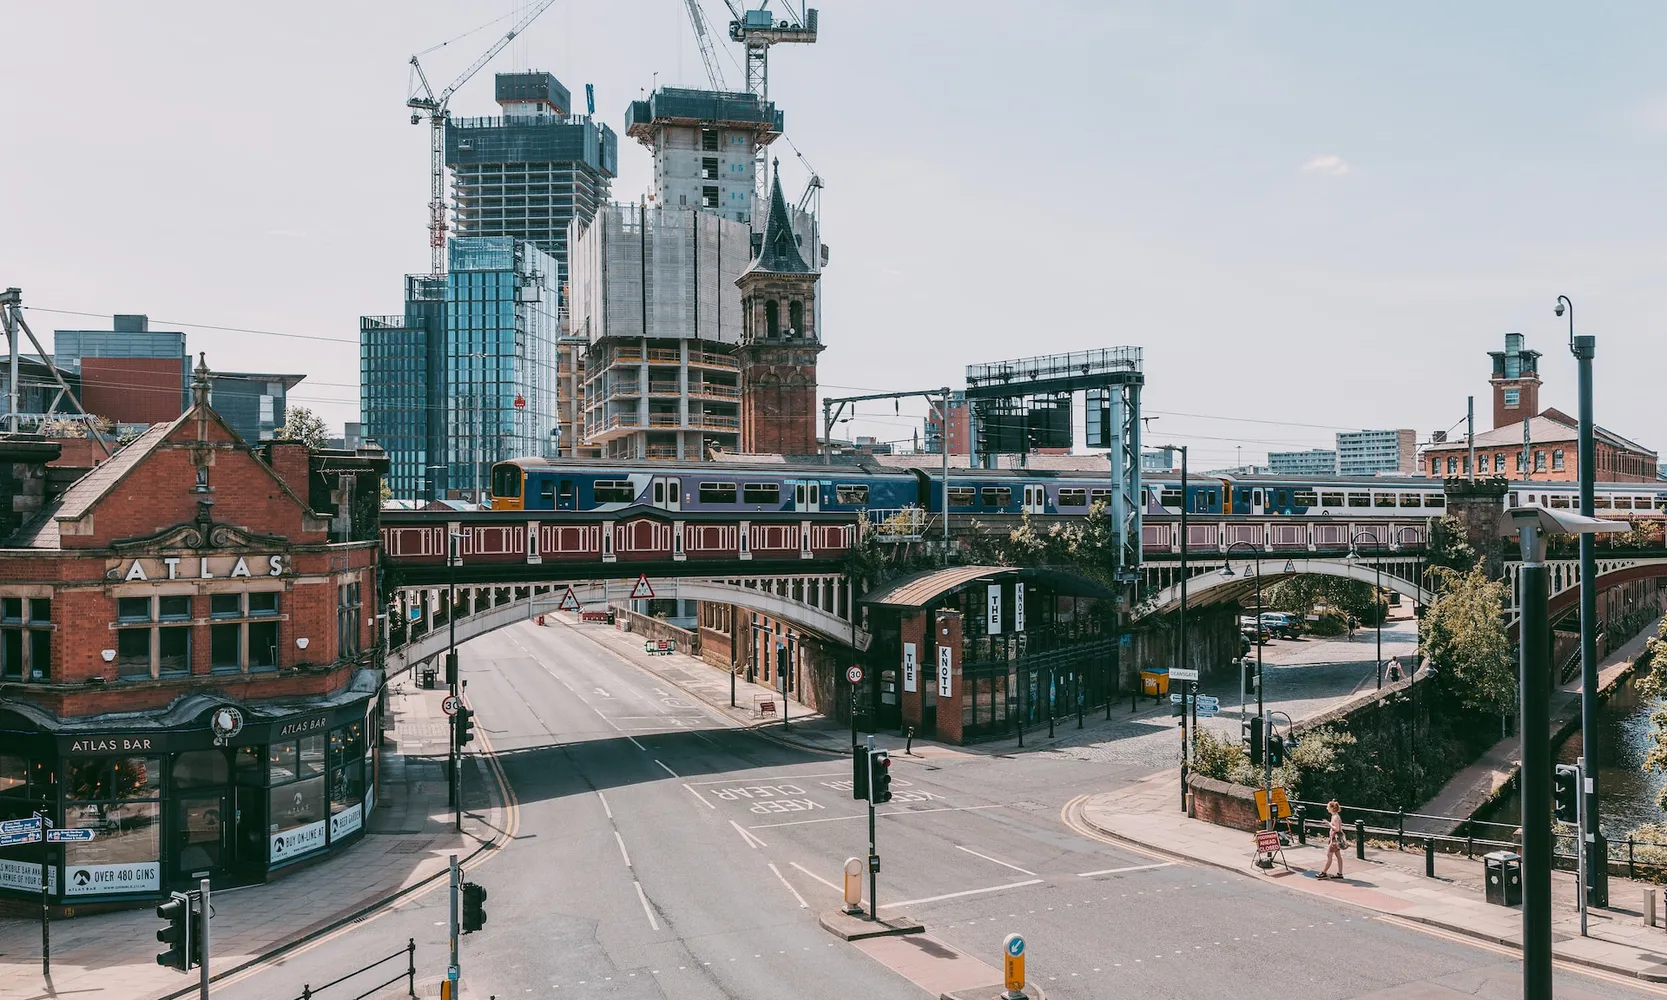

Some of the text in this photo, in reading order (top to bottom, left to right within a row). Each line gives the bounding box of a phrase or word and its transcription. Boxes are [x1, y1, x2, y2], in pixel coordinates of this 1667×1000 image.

[731, 164, 744, 172] 15
[125, 555, 283, 581] ATLAS
[850, 670, 861, 678] 30
[445, 701, 459, 710] 30
[281, 717, 326, 736] ATLAS BAR
[71, 739, 151, 752] ATLAS BAR
[711, 784, 806, 801] CLEAR
[750, 798, 826, 814] KEEP
[285, 836, 296, 848] BUY
[297, 829, 317, 844] ON-LINE
[317, 826, 324, 836] AT
[1260, 838, 1276, 846] AHEAD
[1259, 844, 1279, 852] CLOSED
[5, 864, 20, 874] MOBILE
[22, 866, 30, 875] BAR
[94, 868, 155, 883] OVER 480 GINS
[18, 874, 24, 883] OF
[25, 876, 36, 885] YOUR
